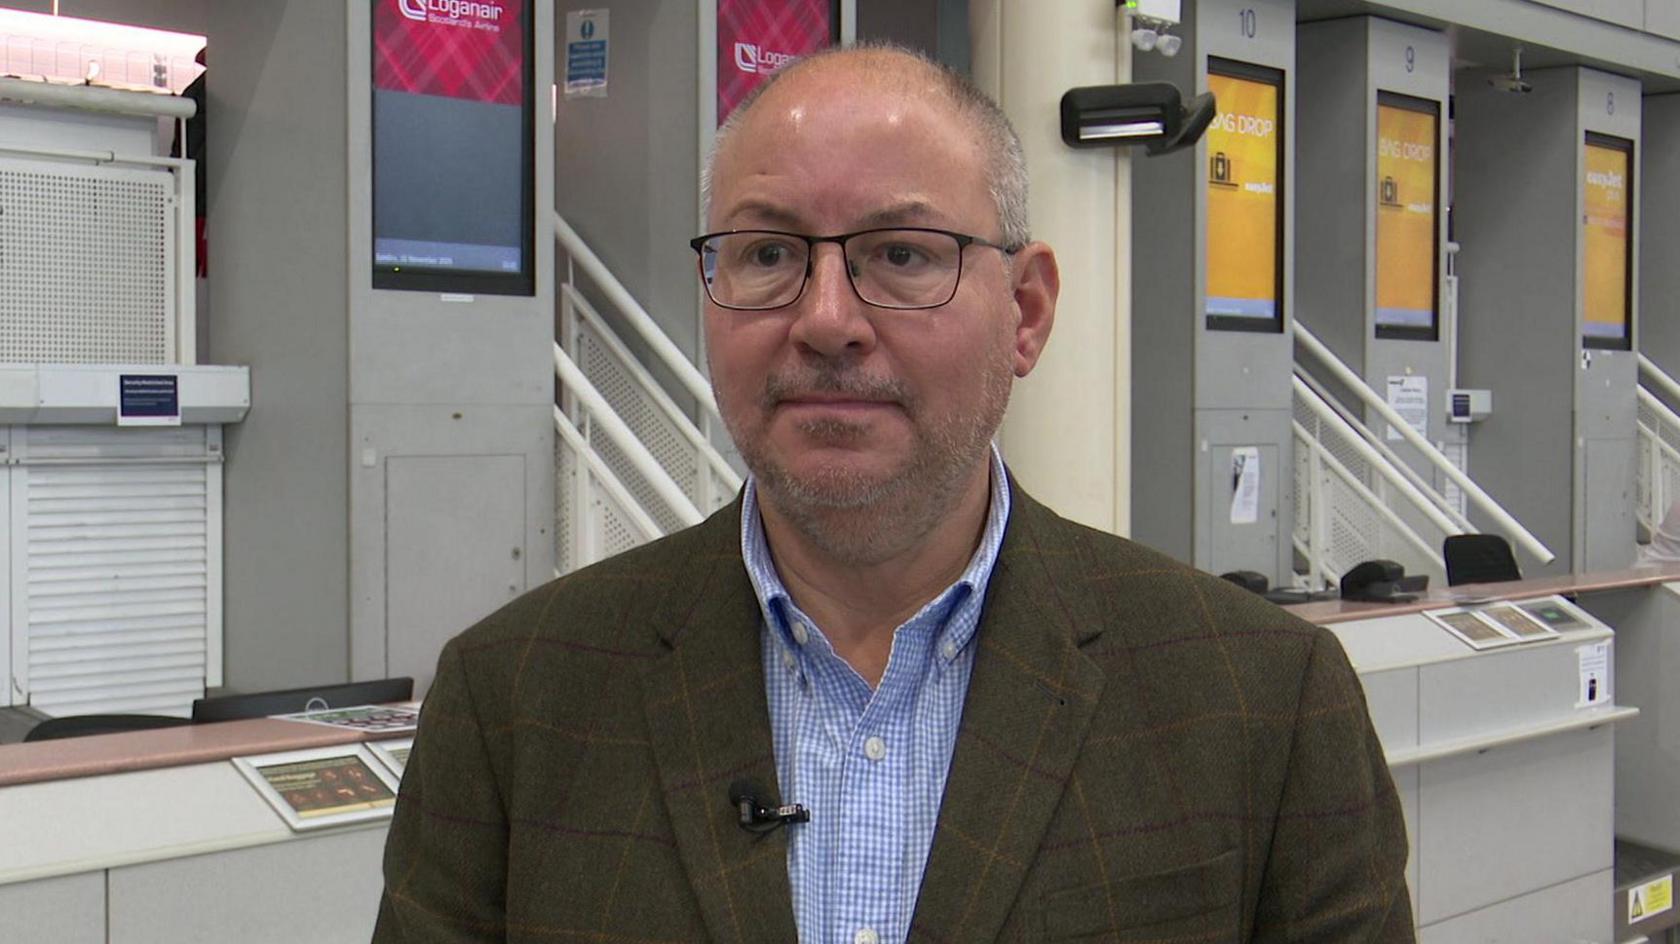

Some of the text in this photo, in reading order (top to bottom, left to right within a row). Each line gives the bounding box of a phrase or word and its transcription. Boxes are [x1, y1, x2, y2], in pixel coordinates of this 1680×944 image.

[428, 0, 503, 20] Loganair
[1239, 8, 1256, 38] 10
[757, 46, 797, 69] Loga
[1405, 45, 1415, 73] 9
[1606, 91, 1614, 116] 8
[1238, 114, 1274, 137] DROP
[1379, 138, 1432, 162] BAG DROP
